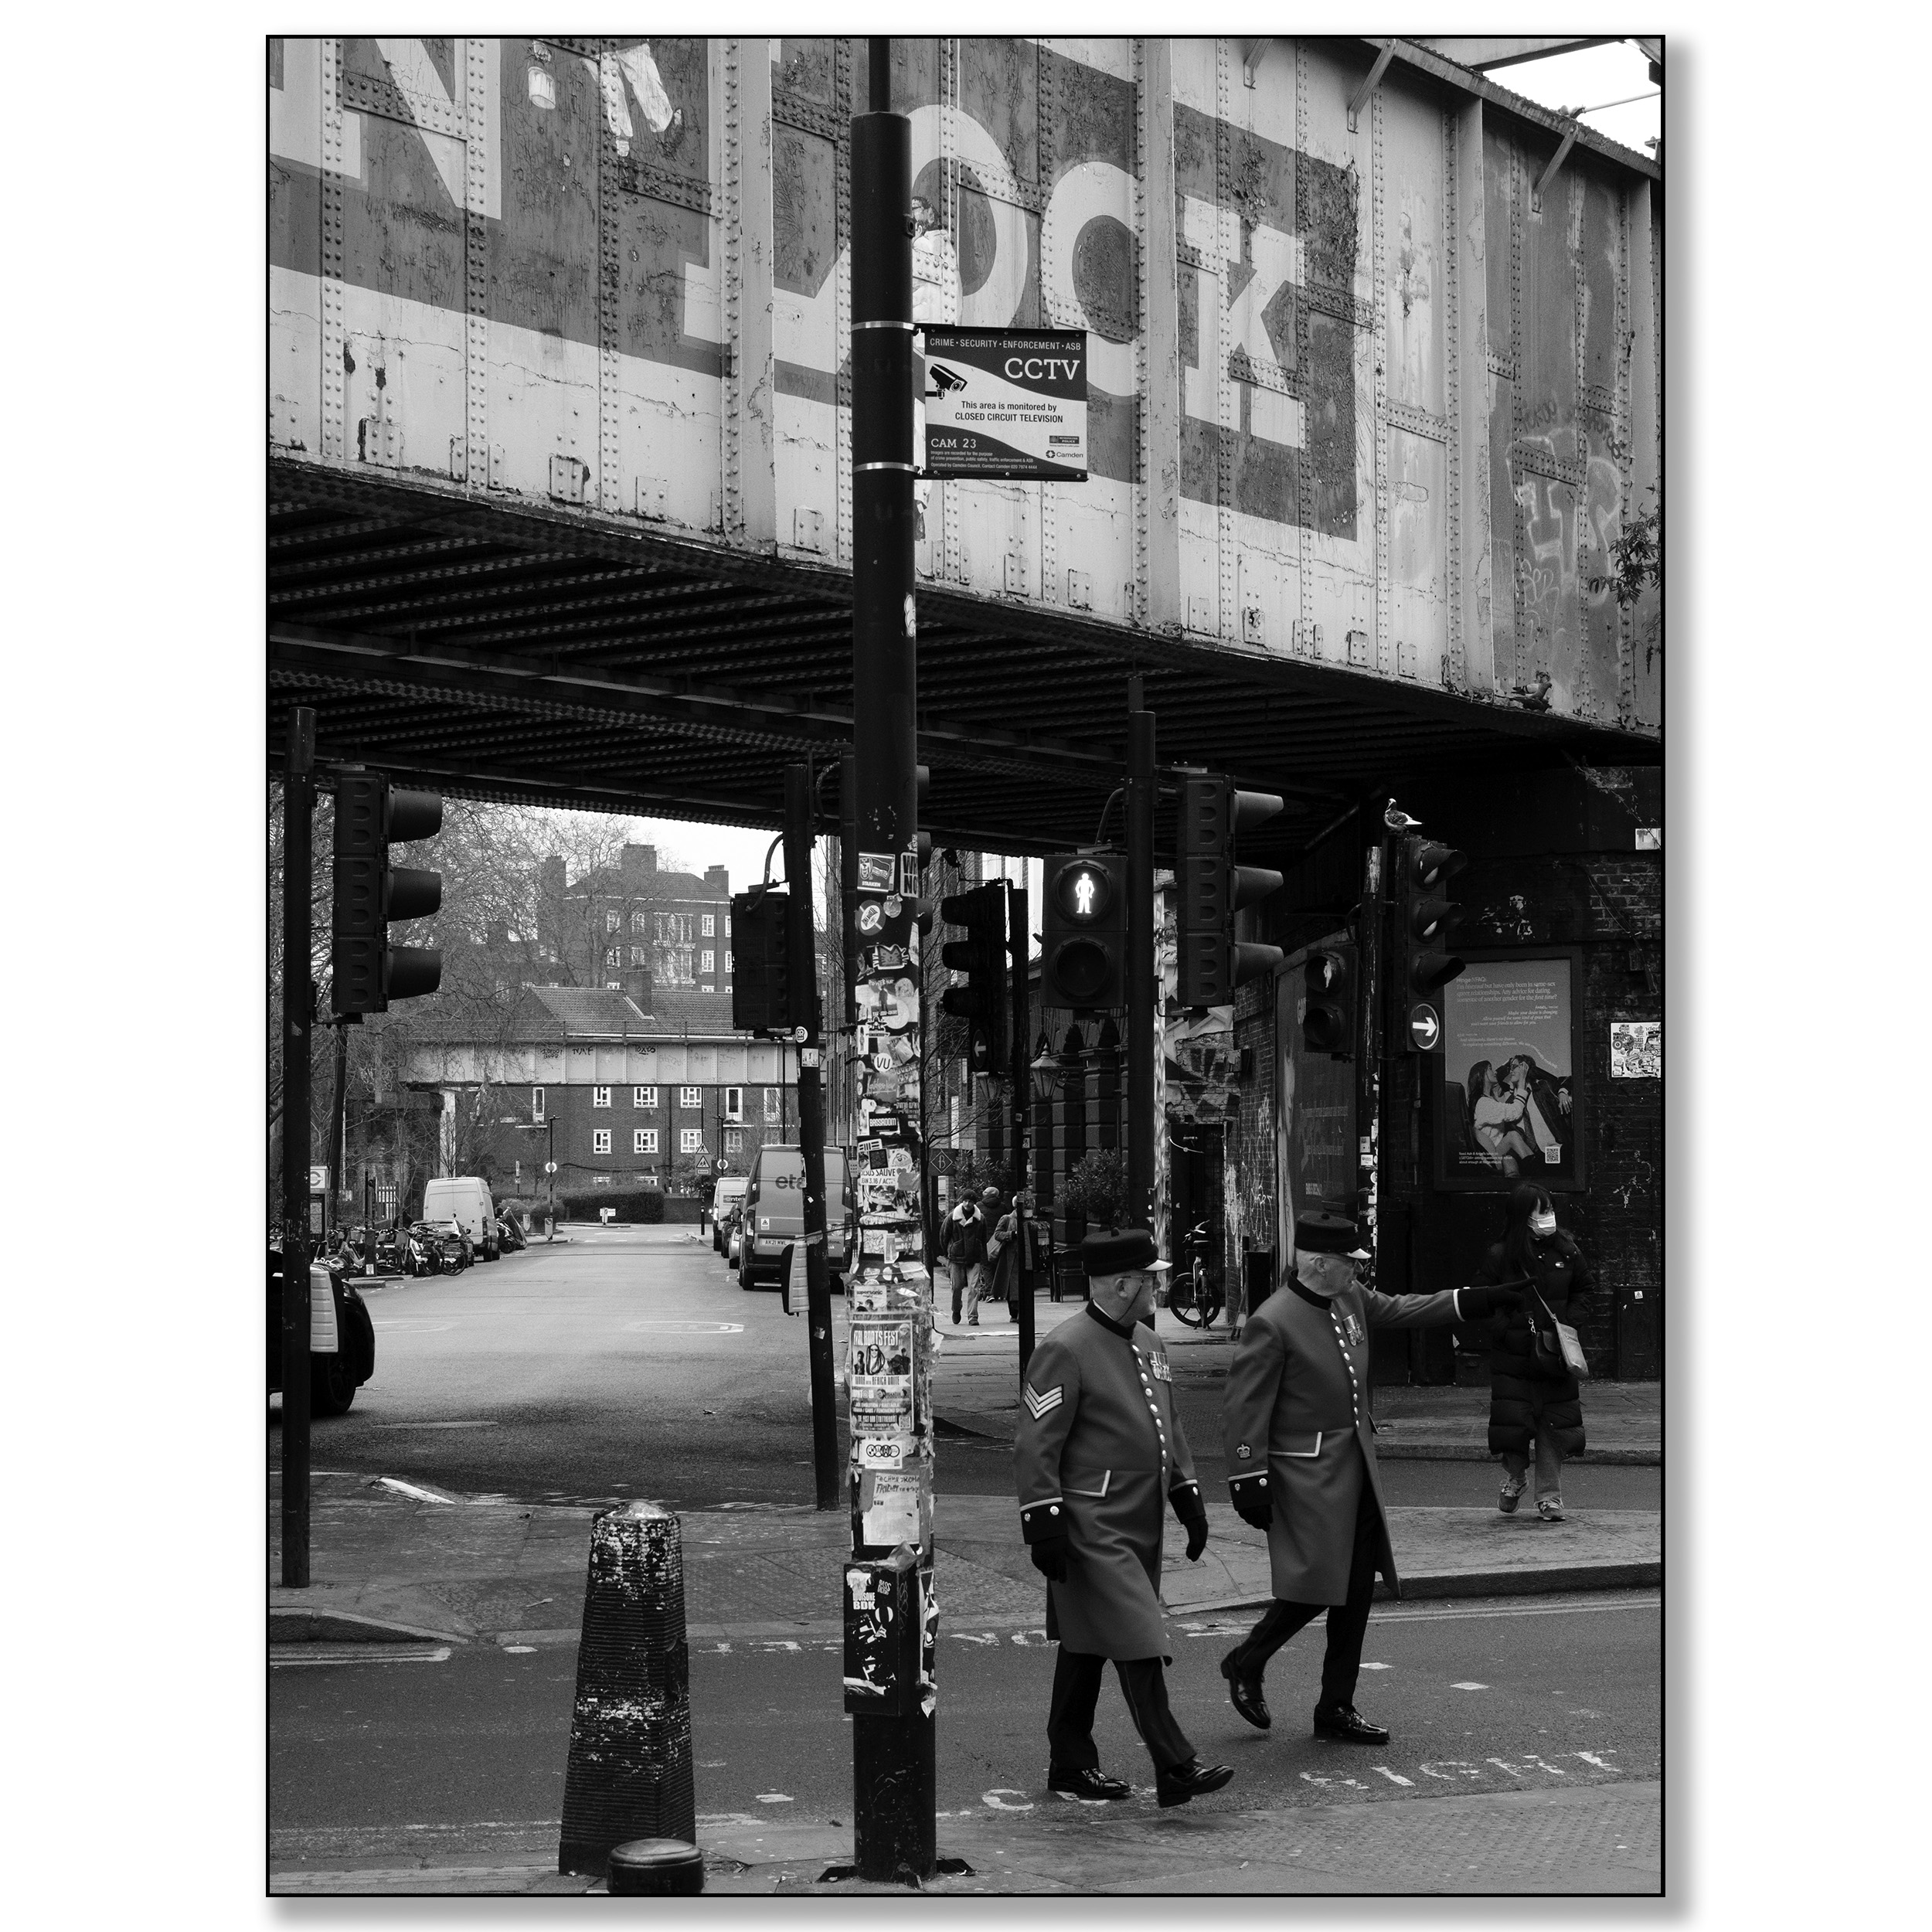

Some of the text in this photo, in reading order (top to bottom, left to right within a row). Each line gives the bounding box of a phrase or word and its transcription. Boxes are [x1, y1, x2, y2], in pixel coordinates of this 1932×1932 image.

[930, 338, 1081, 351] CRIME SECURITY ENFORCEMENT ASB
[1005, 357, 1080, 380] CCTV
[961, 400, 978, 409] This
[998, 401, 1005, 410] is
[1007, 402, 1046, 411] monitored
[1048, 403, 1056, 412] by
[954, 412, 1063, 423] CLOSED CIRCUIT TELEVISION
[930, 437, 977, 448] CAM 23
[876, 1056, 891, 1070] VU
[938, 1155, 946, 1168] B
[876, 1168, 896, 1177] SAUVE
[864, 1330, 883, 1346] ROOTS
[884, 1330, 899, 1346] FEST
[853, 1600, 876, 1610] BDK
